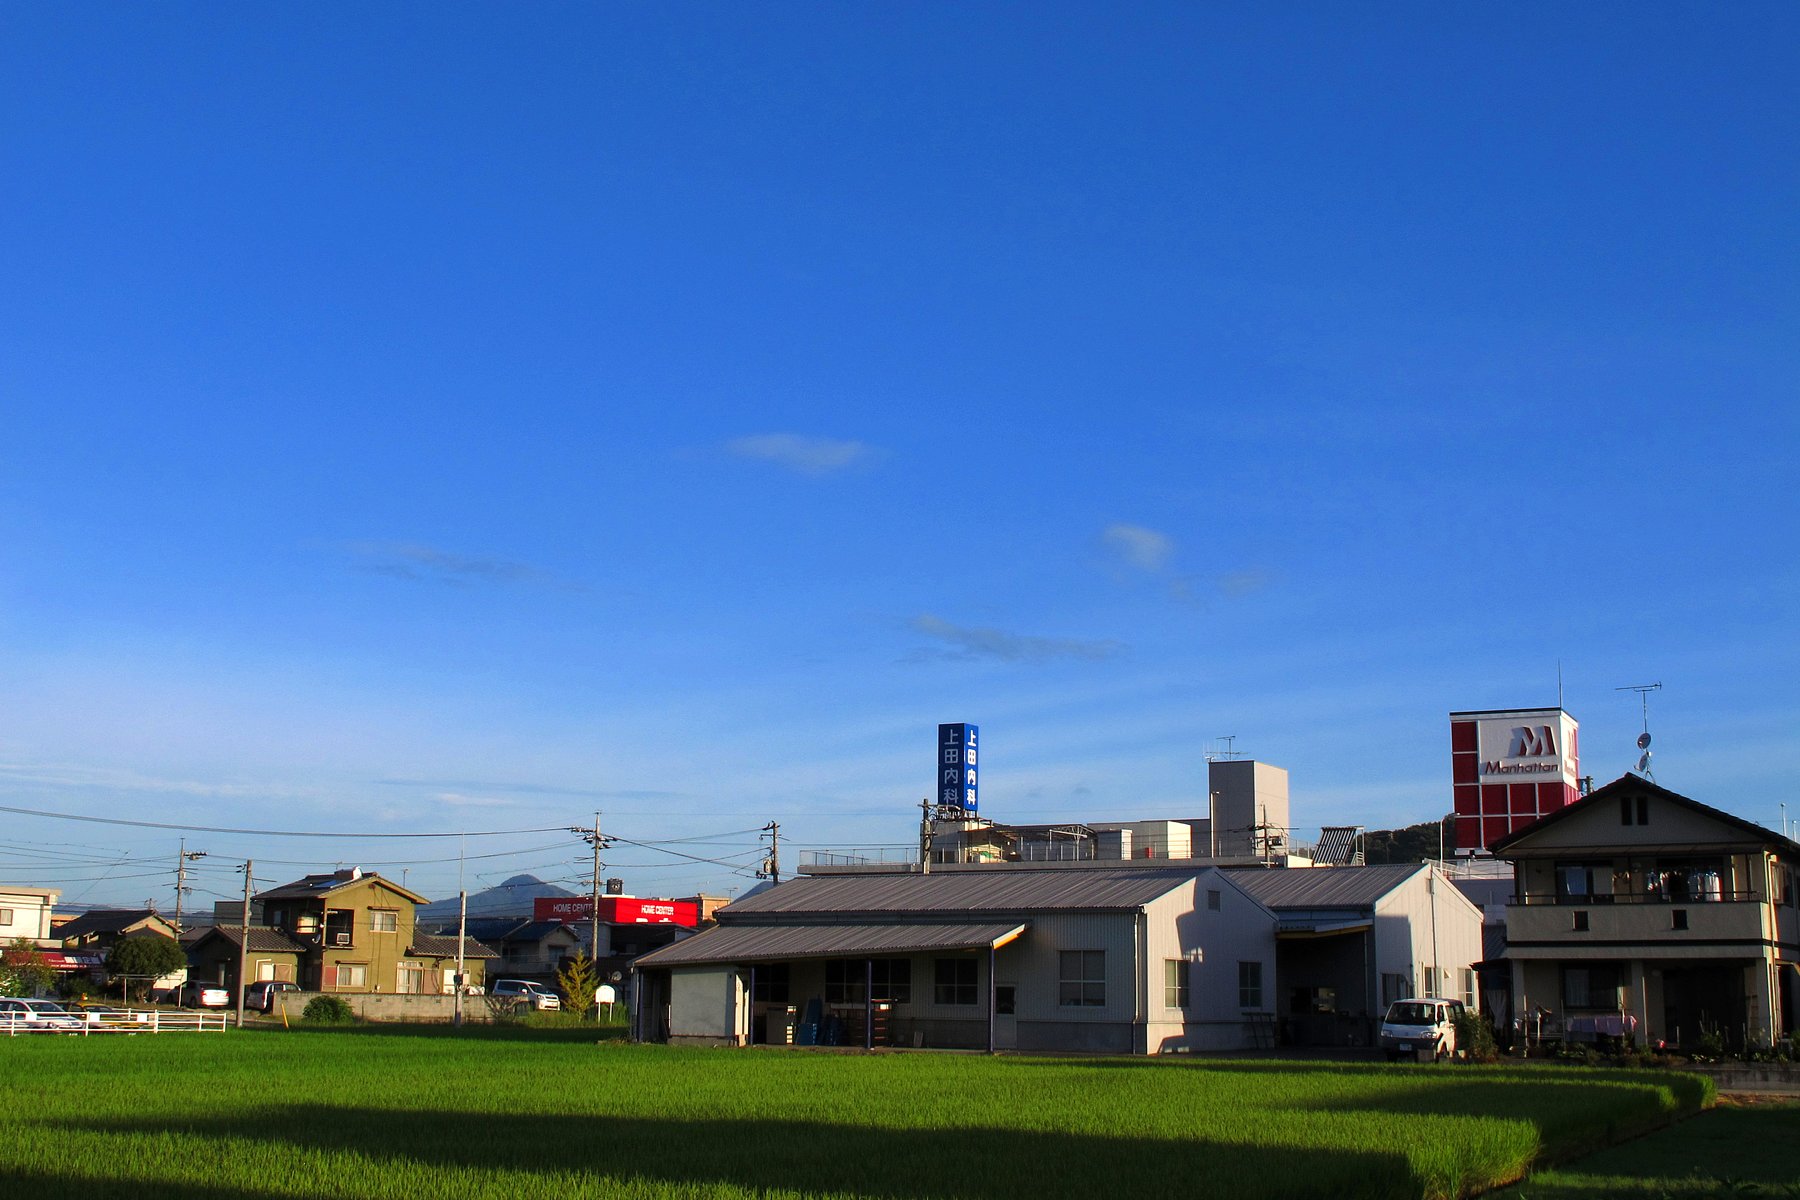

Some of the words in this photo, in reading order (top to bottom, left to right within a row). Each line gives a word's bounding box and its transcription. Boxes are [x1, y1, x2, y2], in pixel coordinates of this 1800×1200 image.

[944, 729, 958, 804] 上田内科
[967, 729, 976, 805] 上田内科
[1485, 760, 1558, 774] Manhattan
[553, 903, 571, 913] HOME
[641, 905, 655, 914] HOME
[656, 906, 674, 915] CENTER
